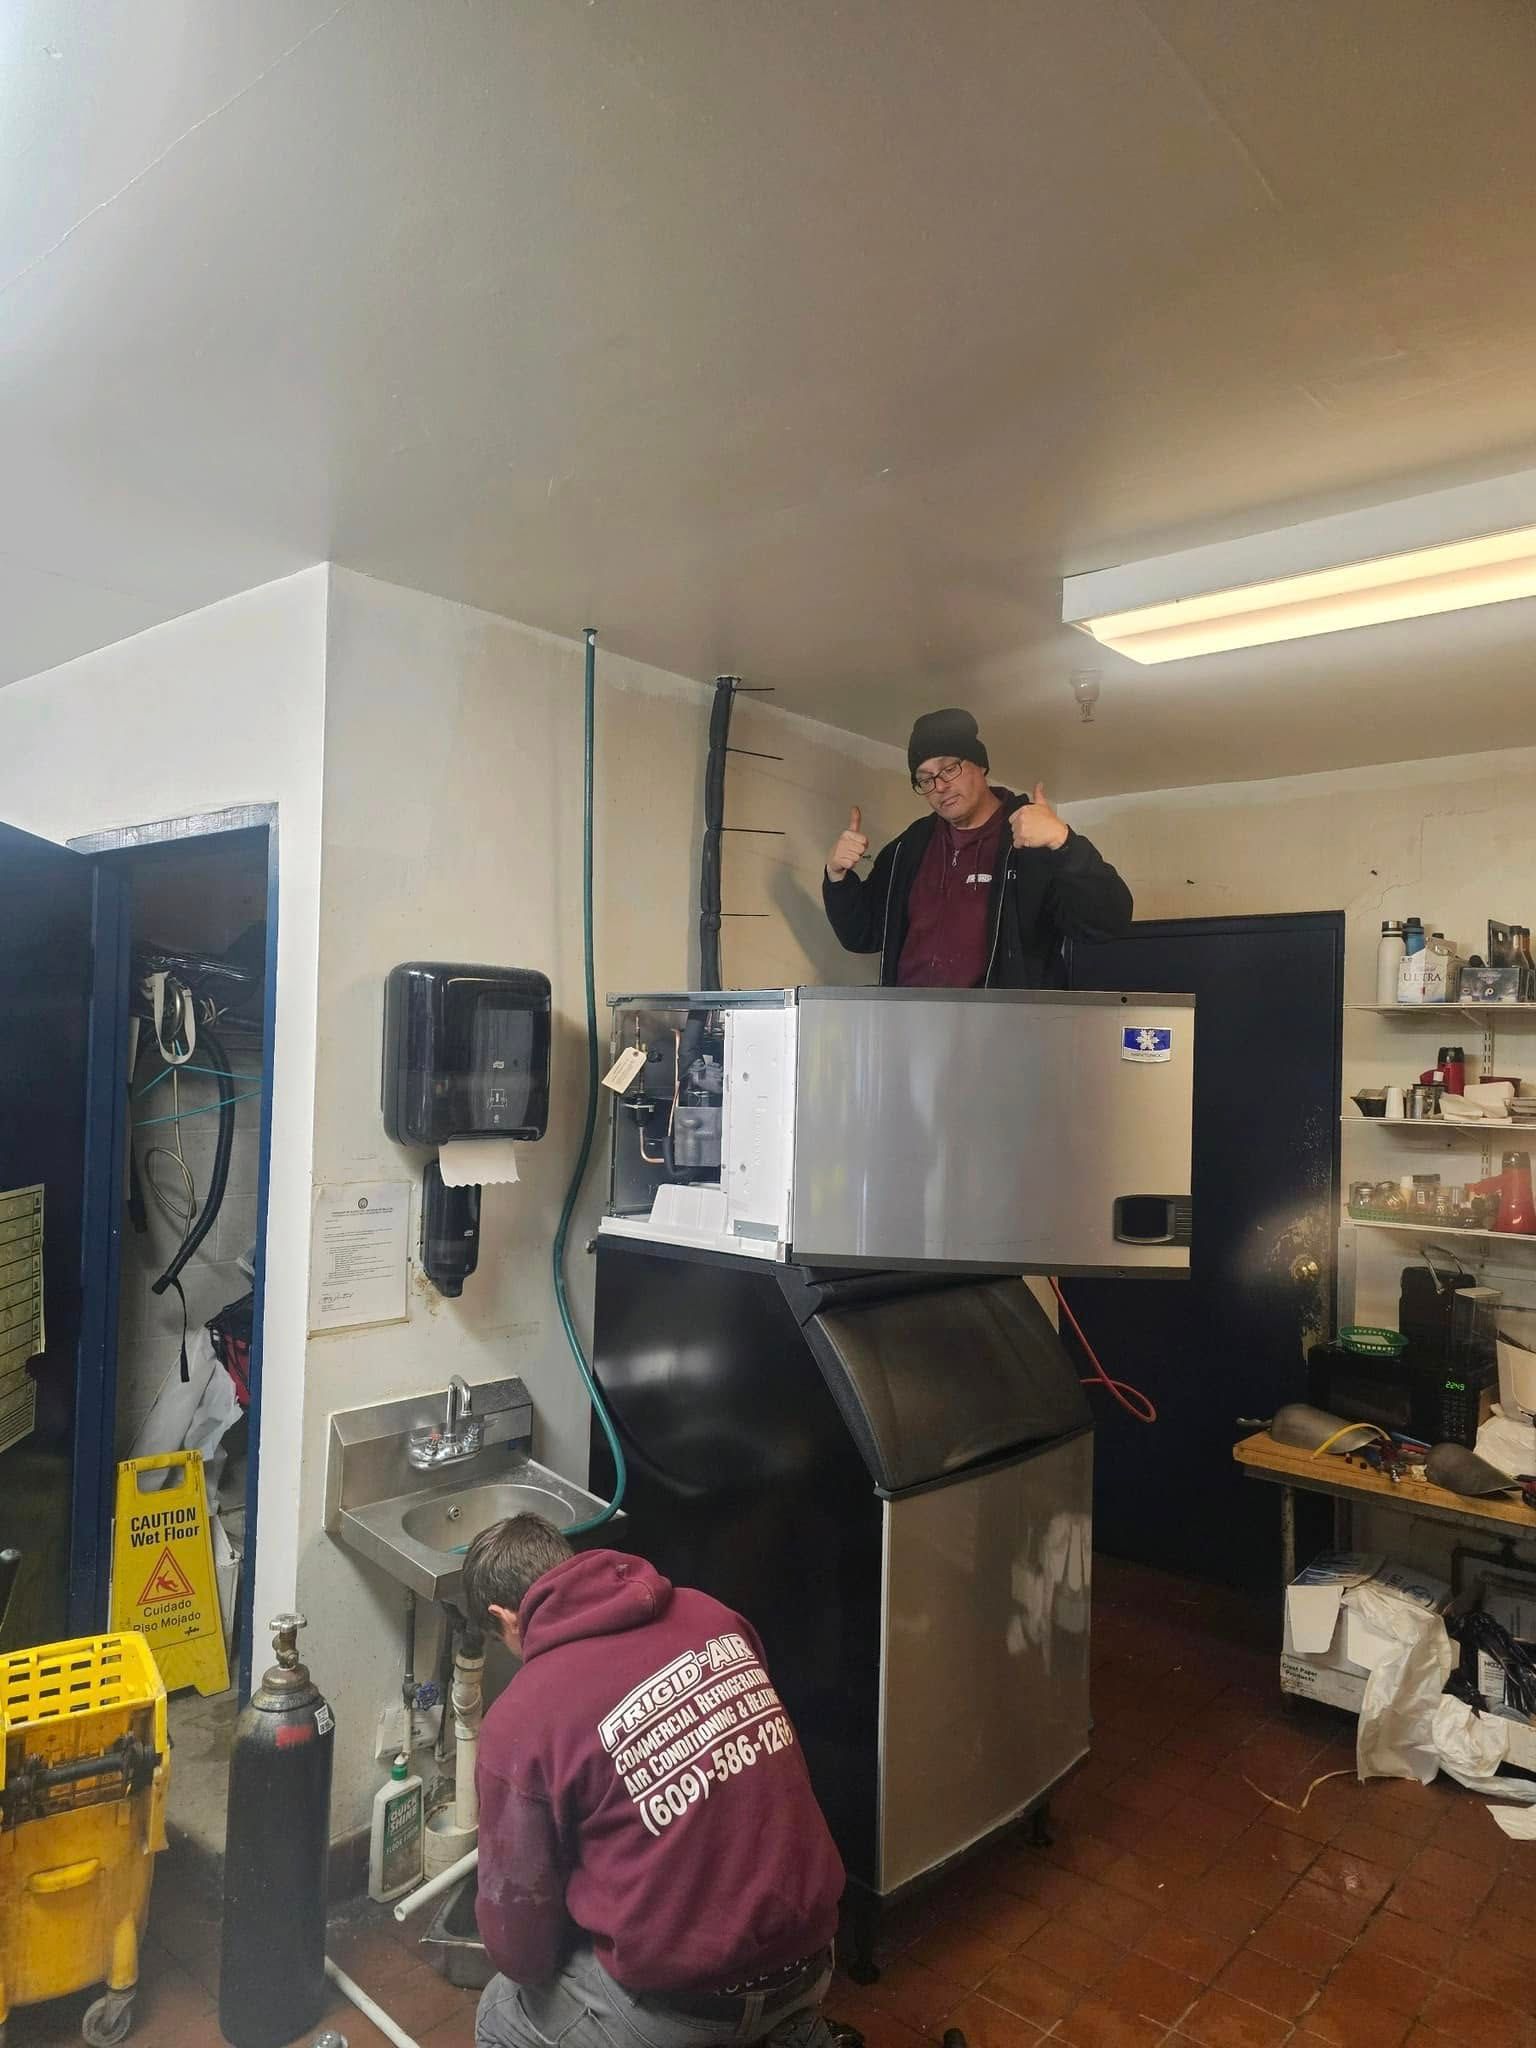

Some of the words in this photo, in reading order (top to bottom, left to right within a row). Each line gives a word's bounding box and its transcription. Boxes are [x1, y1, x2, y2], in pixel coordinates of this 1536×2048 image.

[1403, 972, 1441, 982] ULTRA
[131, 1506, 196, 1532] CAUTION
[131, 1531, 160, 1548] Wet
[164, 1525, 200, 1542] Floor
[143, 1599, 192, 1618] Cuidado
[133, 1621, 158, 1633] Piso
[160, 1611, 201, 1629] Mojado
[1286, 1669, 1315, 1682] Products
[598, 1633, 755, 1752] FRIGID-AIR
[615, 1704, 699, 1776] COMMERCIAL
[623, 1770, 653, 1796] AIR
[648, 1706, 738, 1777] CONDITIONING
[736, 1700, 750, 1719] &
